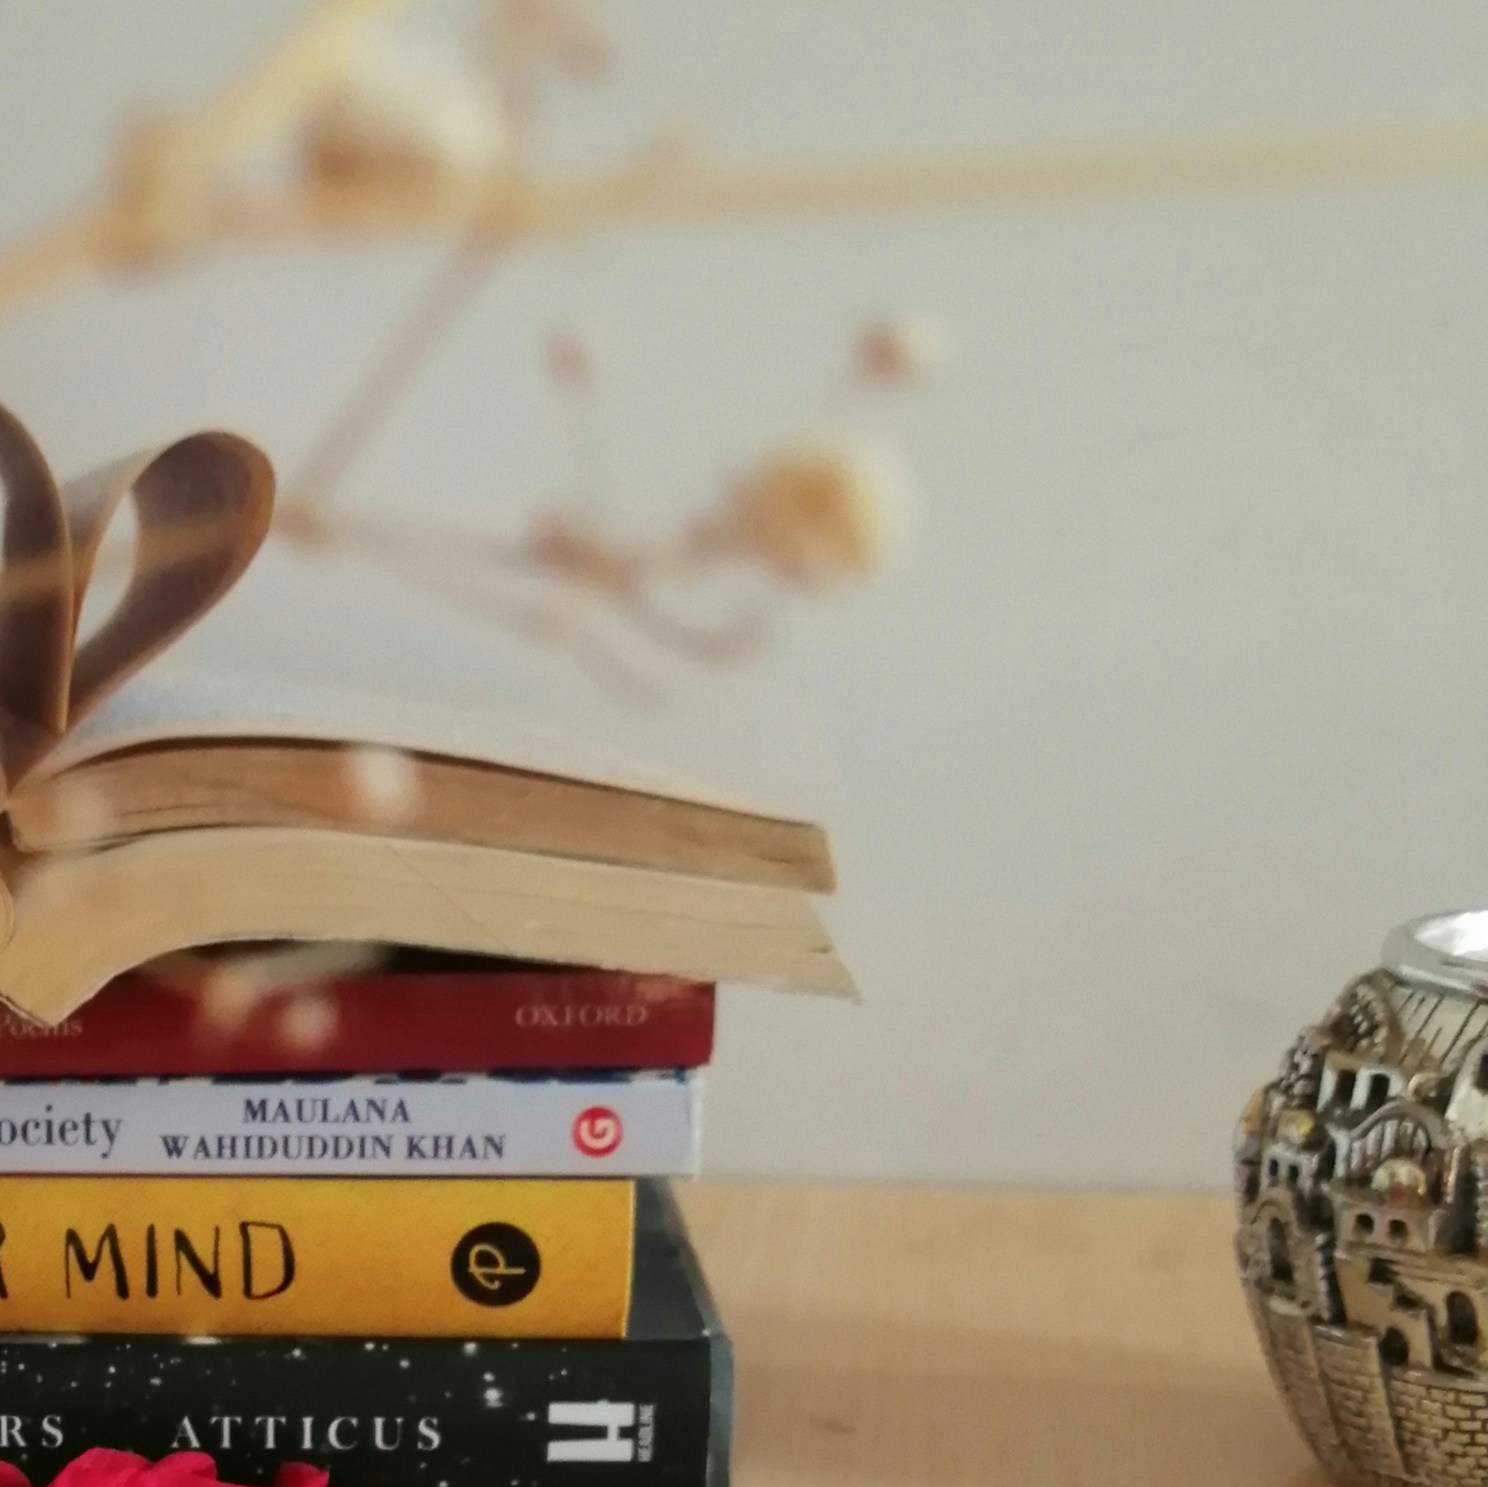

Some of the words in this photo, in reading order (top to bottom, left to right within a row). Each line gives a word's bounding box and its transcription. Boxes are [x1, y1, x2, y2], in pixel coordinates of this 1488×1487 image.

[515, 1003, 649, 1027] OXFORD
[242, 1098, 411, 1125] MAULANA
[160, 1134, 394, 1160] WAHIDUDDIN
[405, 1134, 507, 1160] KHAN
[65, 1219, 296, 1301] MIND
[169, 1415, 443, 1451] ATTICUS
